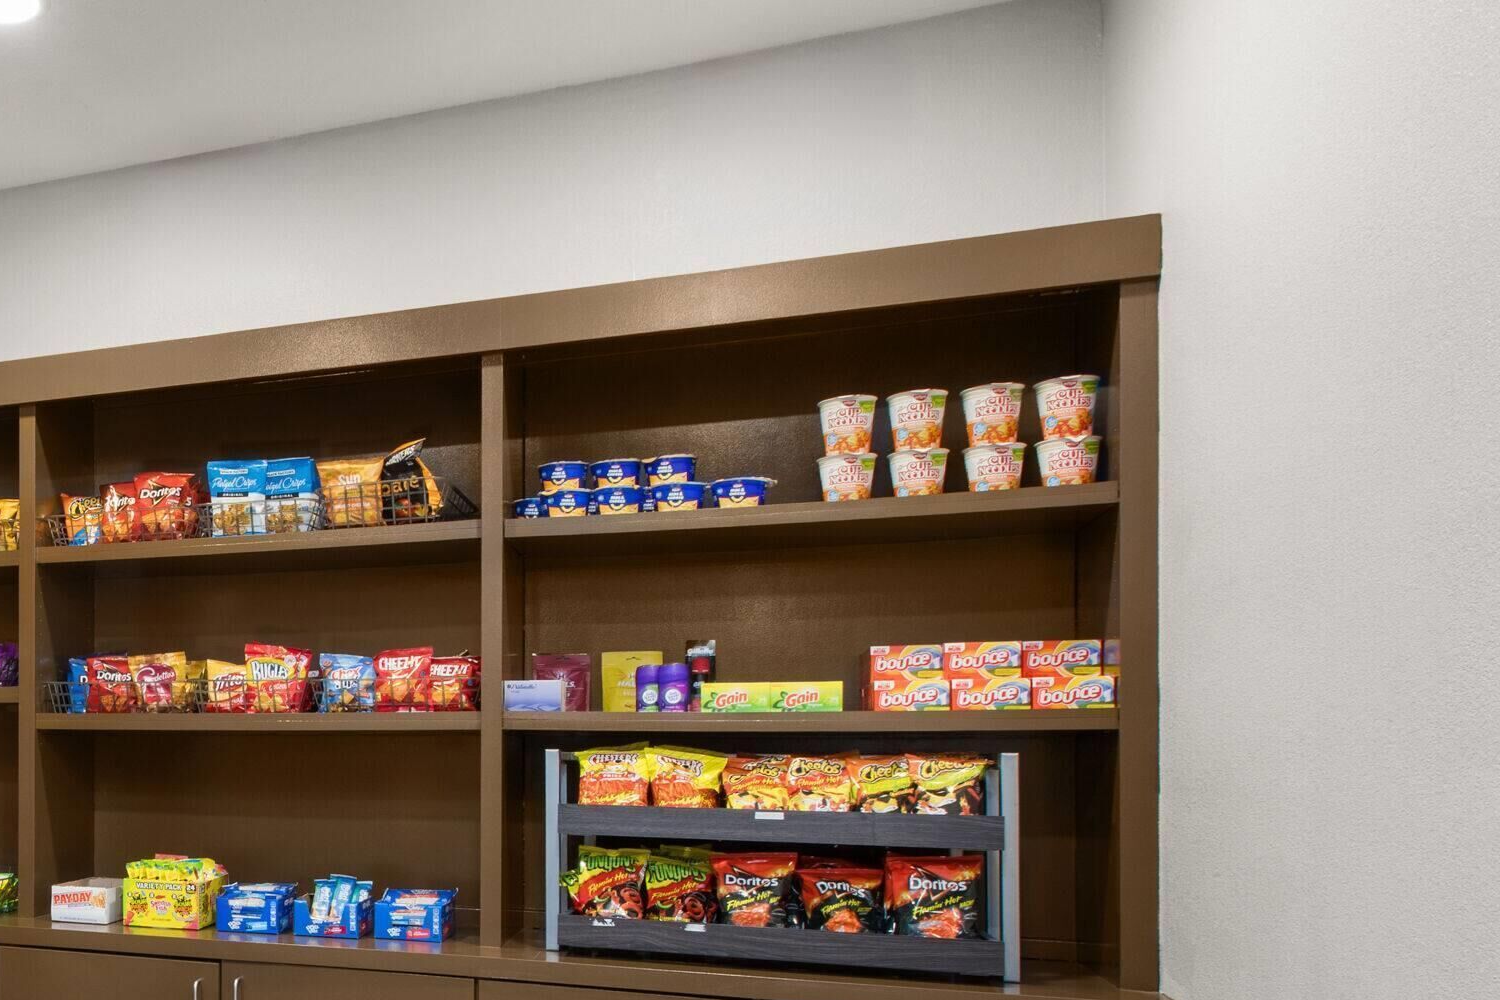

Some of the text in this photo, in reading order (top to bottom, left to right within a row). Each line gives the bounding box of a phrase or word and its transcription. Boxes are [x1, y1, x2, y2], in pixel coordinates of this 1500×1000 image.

[1056, 389, 1085, 400] CUP
[907, 402, 933, 413] CUP
[985, 396, 1012, 407] CUP
[1046, 397, 1092, 412] NOODLES
[836, 407, 862, 418] CUP
[898, 410, 940, 424] NOODLES
[975, 404, 1019, 417] NOODLES
[827, 415, 868, 427] NOODLES
[988, 455, 1014, 465] CUP
[1058, 449, 1086, 460] CUP
[837, 465, 863, 475] CUP
[907, 460, 933, 471] CUP
[977, 463, 1021, 476] NOODLES
[1048, 457, 1094, 470] NOODLES
[338, 472, 361, 485] Sun
[829, 472, 869, 485] NOODLES
[898, 468, 940, 481] NOODLES
[139, 485, 182, 499] Doritos
[875, 652, 932, 672] bounce
[950, 650, 1009, 670] bounce
[1028, 647, 1091, 668] bounce
[96, 670, 132, 683] Doritos
[251, 660, 289, 680] BUGLES
[715, 690, 748, 709] Gain
[785, 690, 819, 709] Gain
[880, 687, 939, 708] bounce
[958, 686, 1020, 706] bounce
[1039, 684, 1102, 706] bounce
[788, 758, 842, 778] Cheetos
[136, 881, 183, 891] VARIETY PACK
[725, 873, 780, 888] Doritos
[909, 875, 970, 892] Doritos
[815, 879, 866, 899] Doritos
[53, 891, 92, 905] PAYDAY
